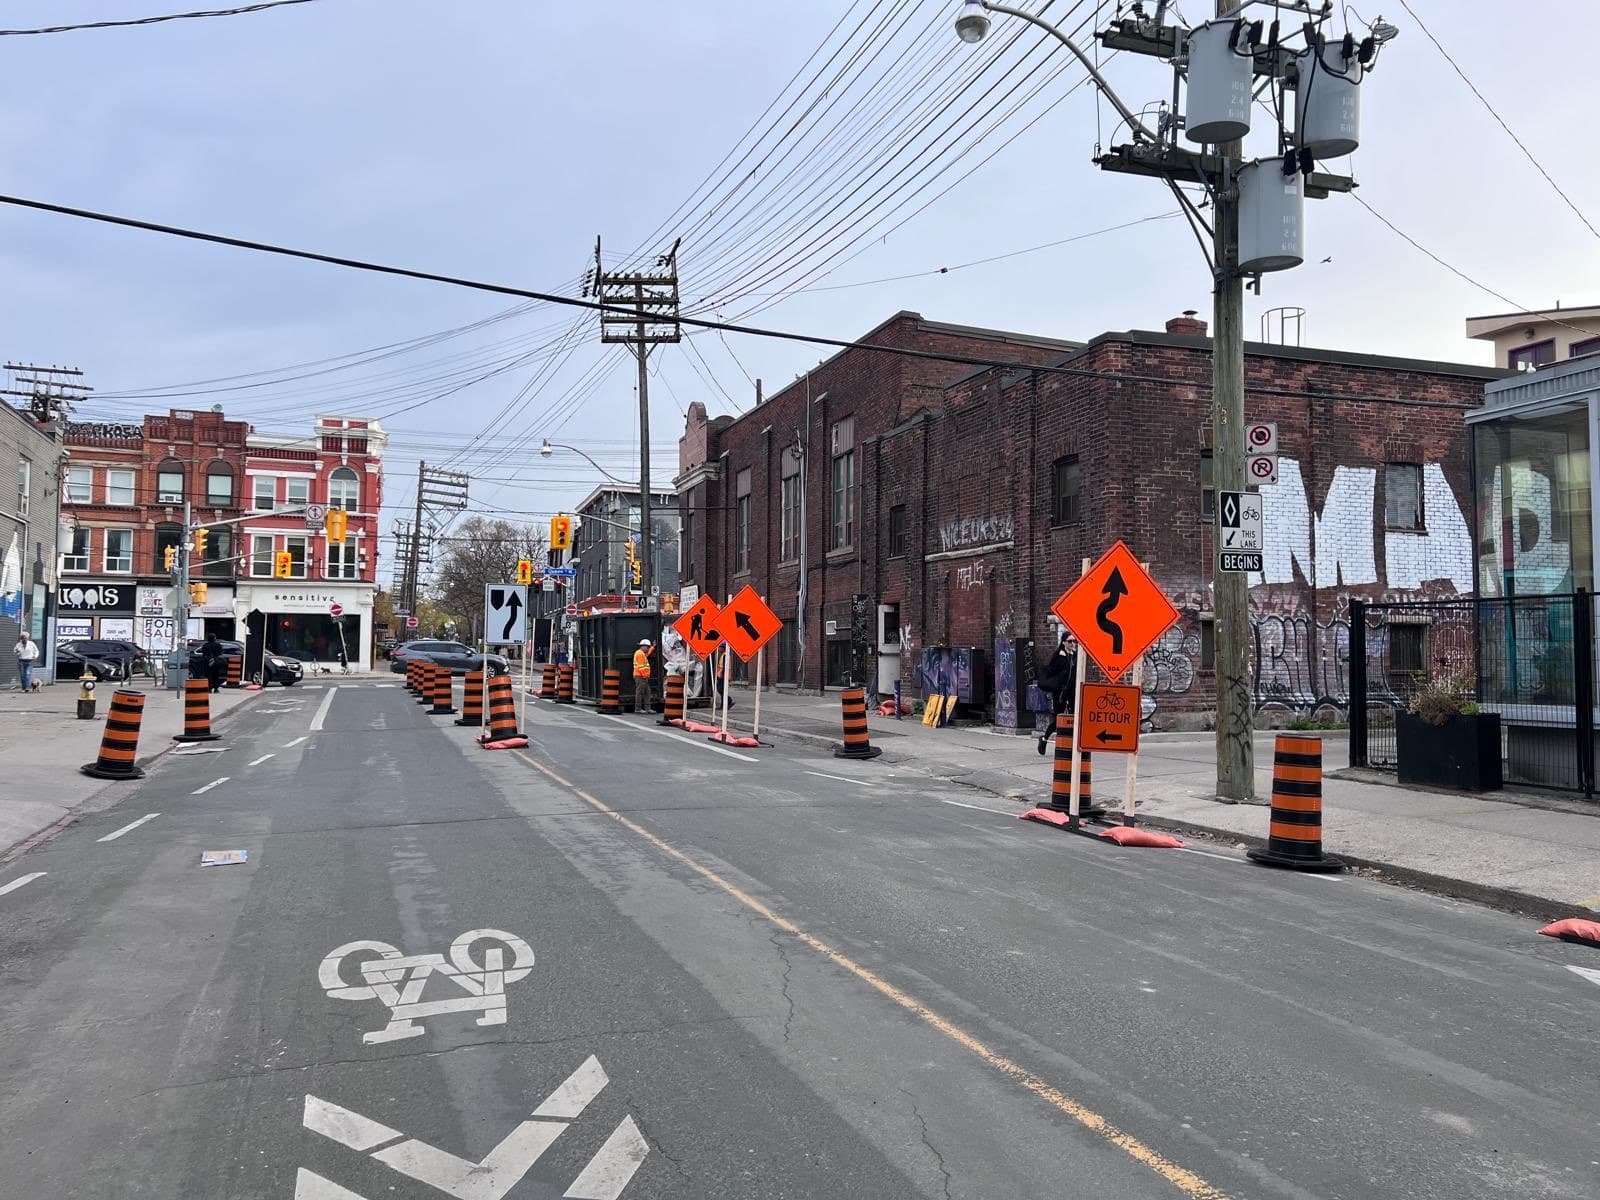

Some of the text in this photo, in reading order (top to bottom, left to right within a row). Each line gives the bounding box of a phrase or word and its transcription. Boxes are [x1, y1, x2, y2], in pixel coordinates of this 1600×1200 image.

[1242, 530, 1256, 539] THIS
[1240, 540, 1257, 549] LANE
[1224, 556, 1260, 570] BEGINS
[60, 626, 89, 636] LEASE
[1089, 711, 1131, 724] DETOUR
